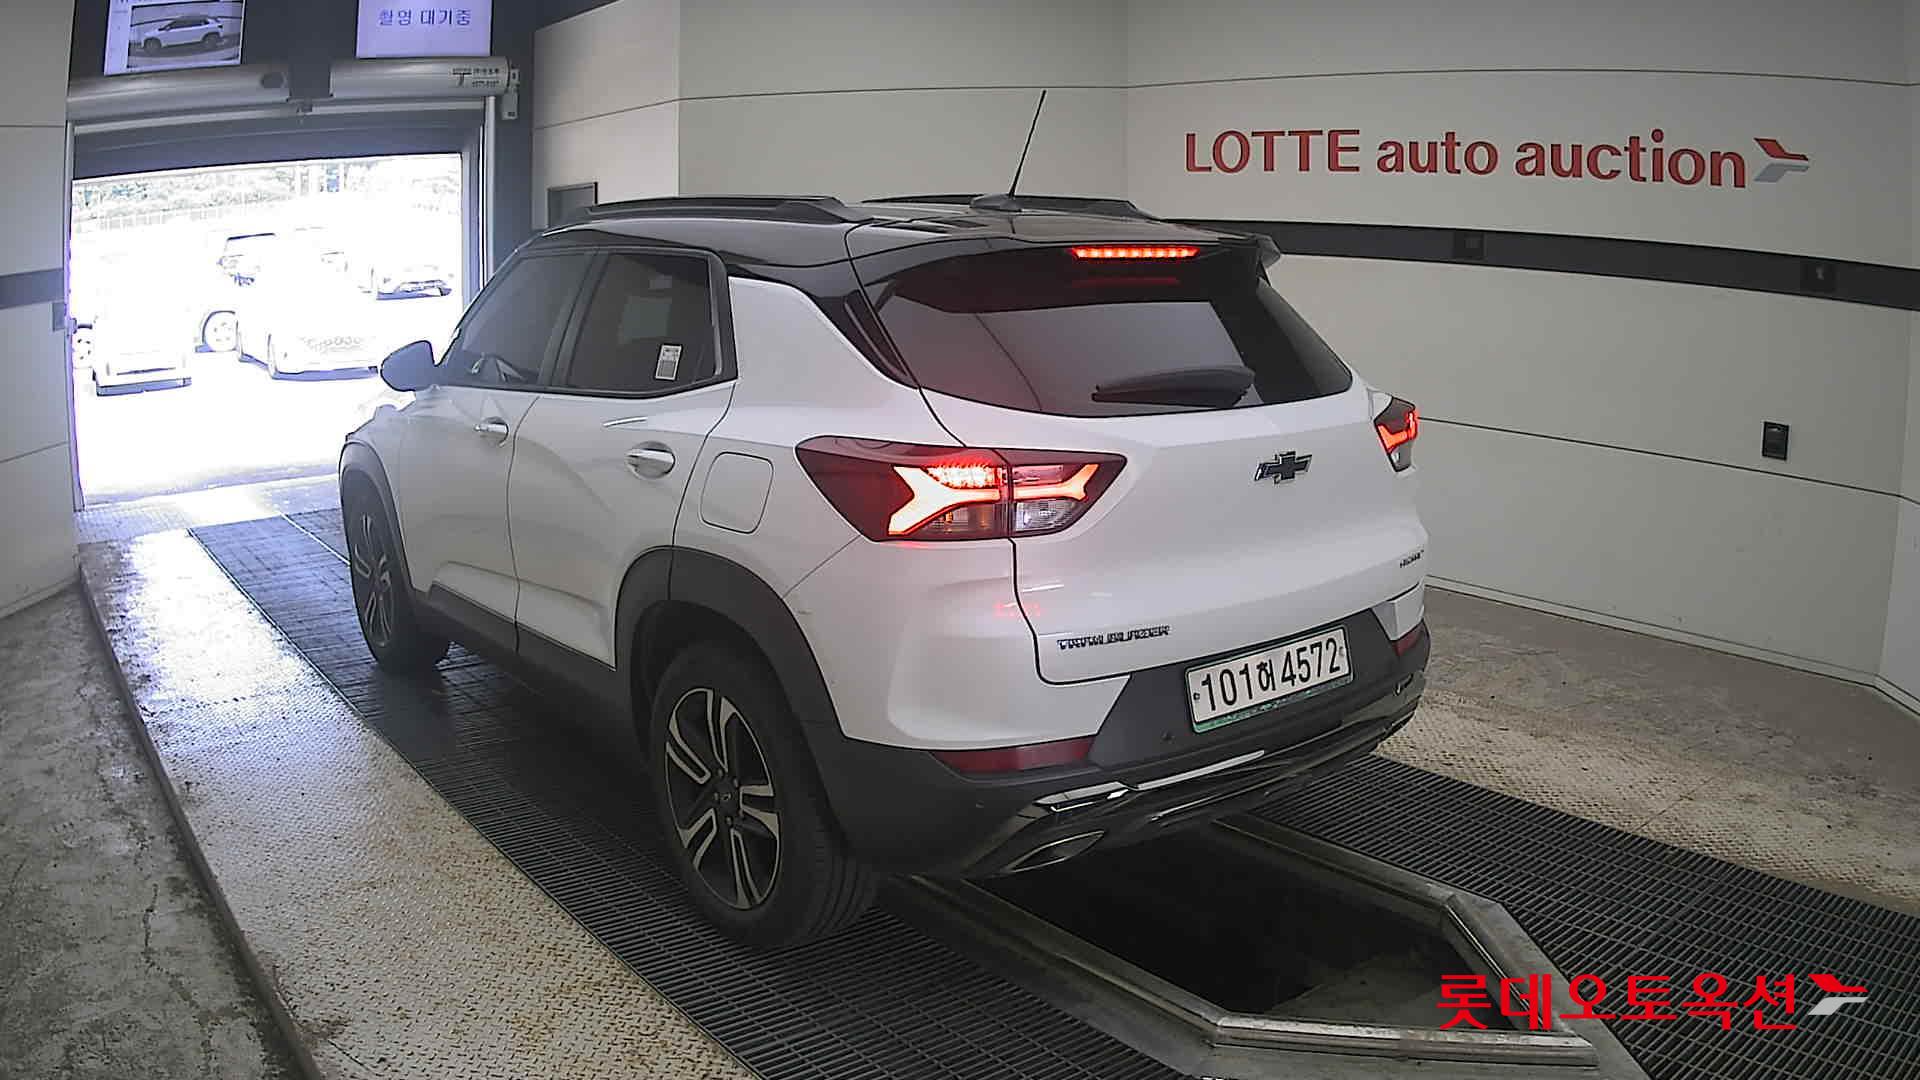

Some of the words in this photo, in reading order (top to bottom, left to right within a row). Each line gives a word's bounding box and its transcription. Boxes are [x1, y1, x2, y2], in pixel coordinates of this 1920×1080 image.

[420, 9, 471, 26] 대기중
[1186, 130, 1360, 173] LOTTE
[1377, 132, 1499, 176] auto
[1515, 129, 1746, 188] auction
